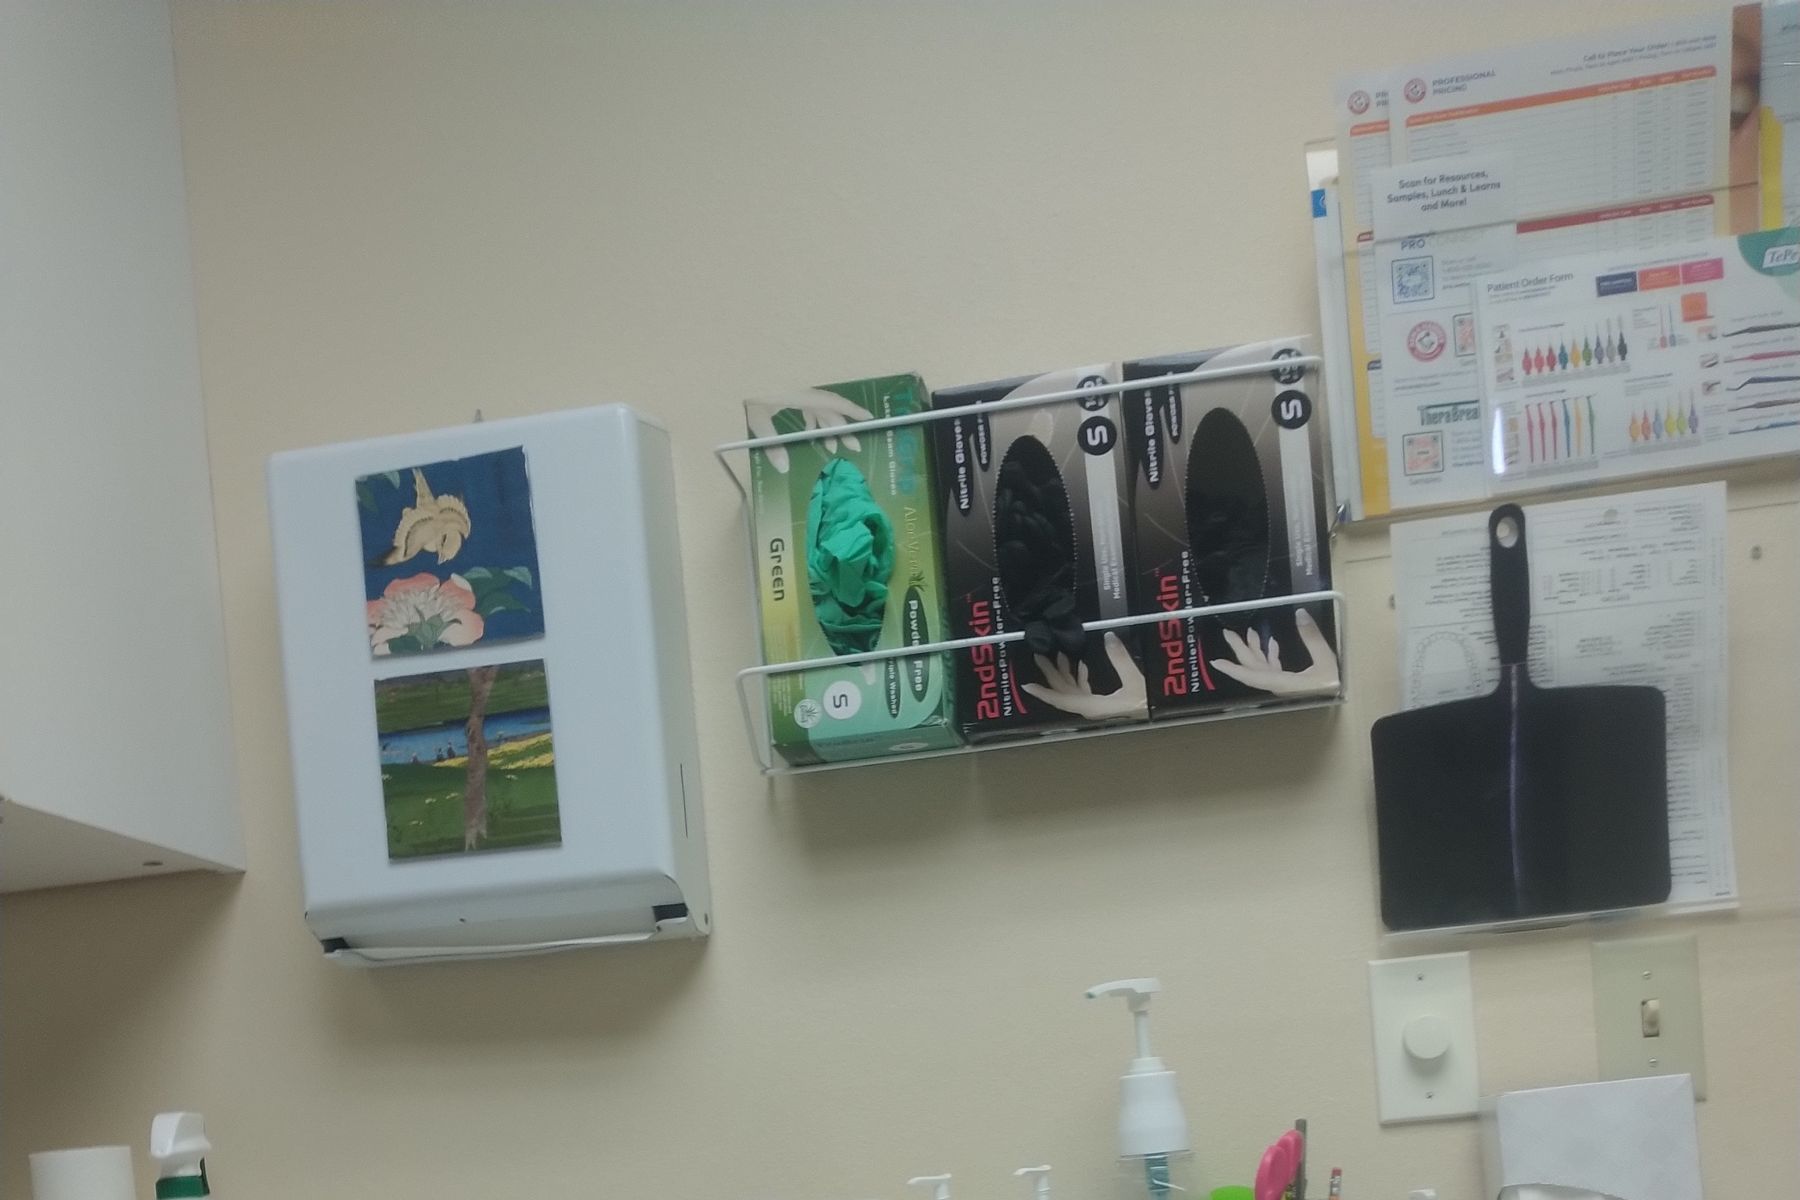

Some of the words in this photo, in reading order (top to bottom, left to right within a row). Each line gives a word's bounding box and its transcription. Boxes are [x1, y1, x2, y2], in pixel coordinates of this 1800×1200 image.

[1432, 70, 1496, 86] PROFESSIONAL
[1432, 84, 1468, 95] PRICING
[1399, 180, 1422, 189] Scan
[1423, 176, 1437, 185] for
[1431, 186, 1458, 197] Lunch
[1460, 184, 1467, 193] &
[1470, 182, 1501, 192] Learns
[1421, 202, 1438, 211] and
[1401, 239, 1426, 250] PRO
[1488, 280, 1519, 292] Patient
[1520, 276, 1548, 288] Order
[1549, 272, 1574, 281] Form
[1281, 399, 1303, 420] S
[1417, 399, 1480, 426] TheraBrea
[1086, 425, 1109, 446] S
[1147, 438, 1159, 483] Nitrile
[888, 460, 897, 496] Gloves
[957, 466, 970, 510] Nitrile
[769, 537, 785, 602] Green
[908, 599, 920, 648] Powde
[913, 660, 924, 692] Free
[832, 693, 848, 709] S
[889, 682, 899, 715] Washed
